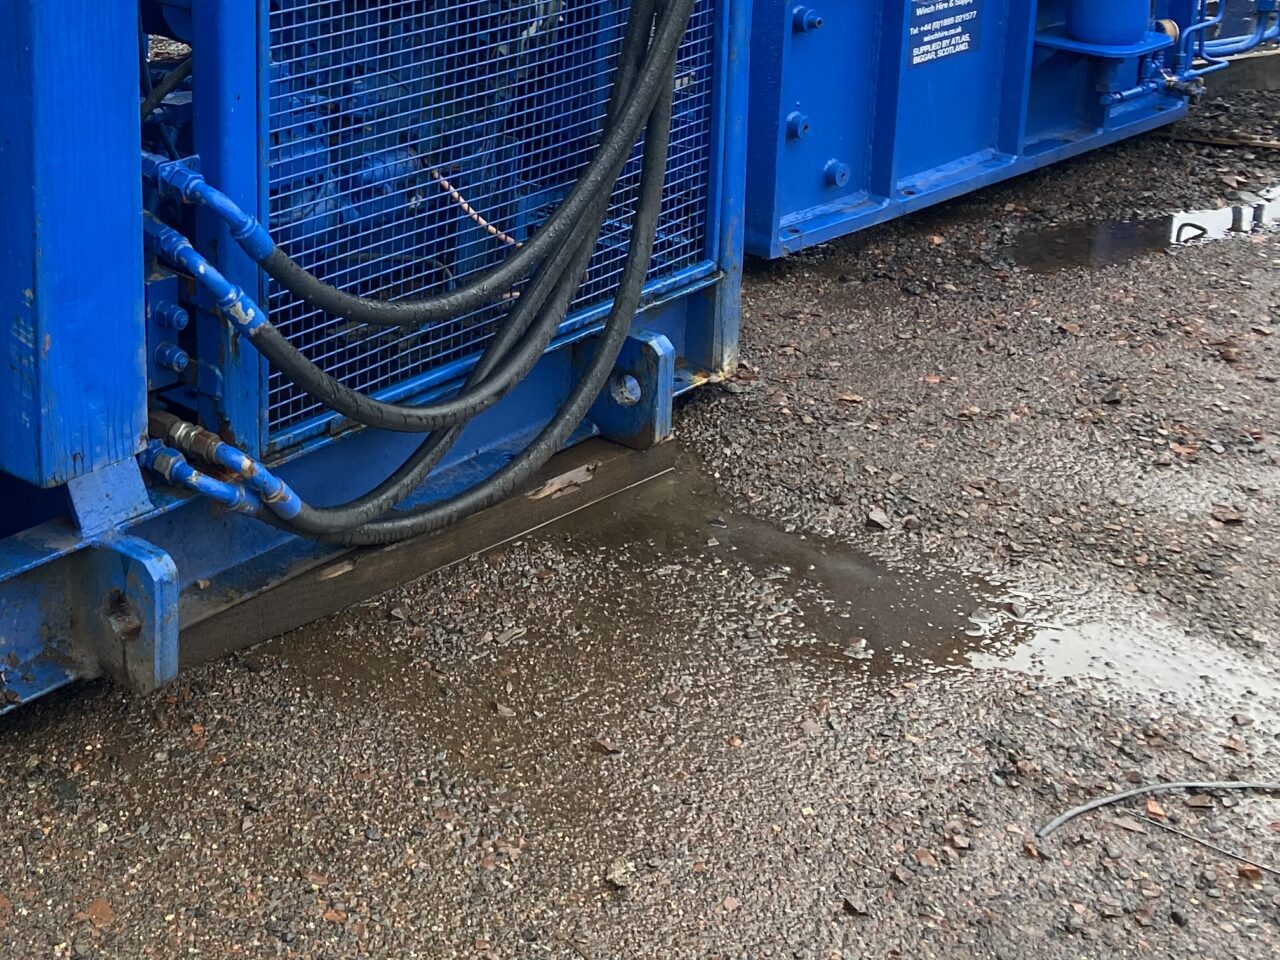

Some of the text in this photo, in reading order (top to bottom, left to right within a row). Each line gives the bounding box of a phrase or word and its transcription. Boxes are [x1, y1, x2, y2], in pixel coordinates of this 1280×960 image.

[916, 5, 934, 16] Winch
[936, 2, 948, 11] Hire
[920, 22, 932, 31] +44
[955, 11, 977, 22] 221577
[923, 26, 962, 42] winchhire.co.uk
[913, 42, 941, 56] SUPPLIED
[942, 38, 951, 47] BY
[937, 42, 969, 57] SCOTLAND.
